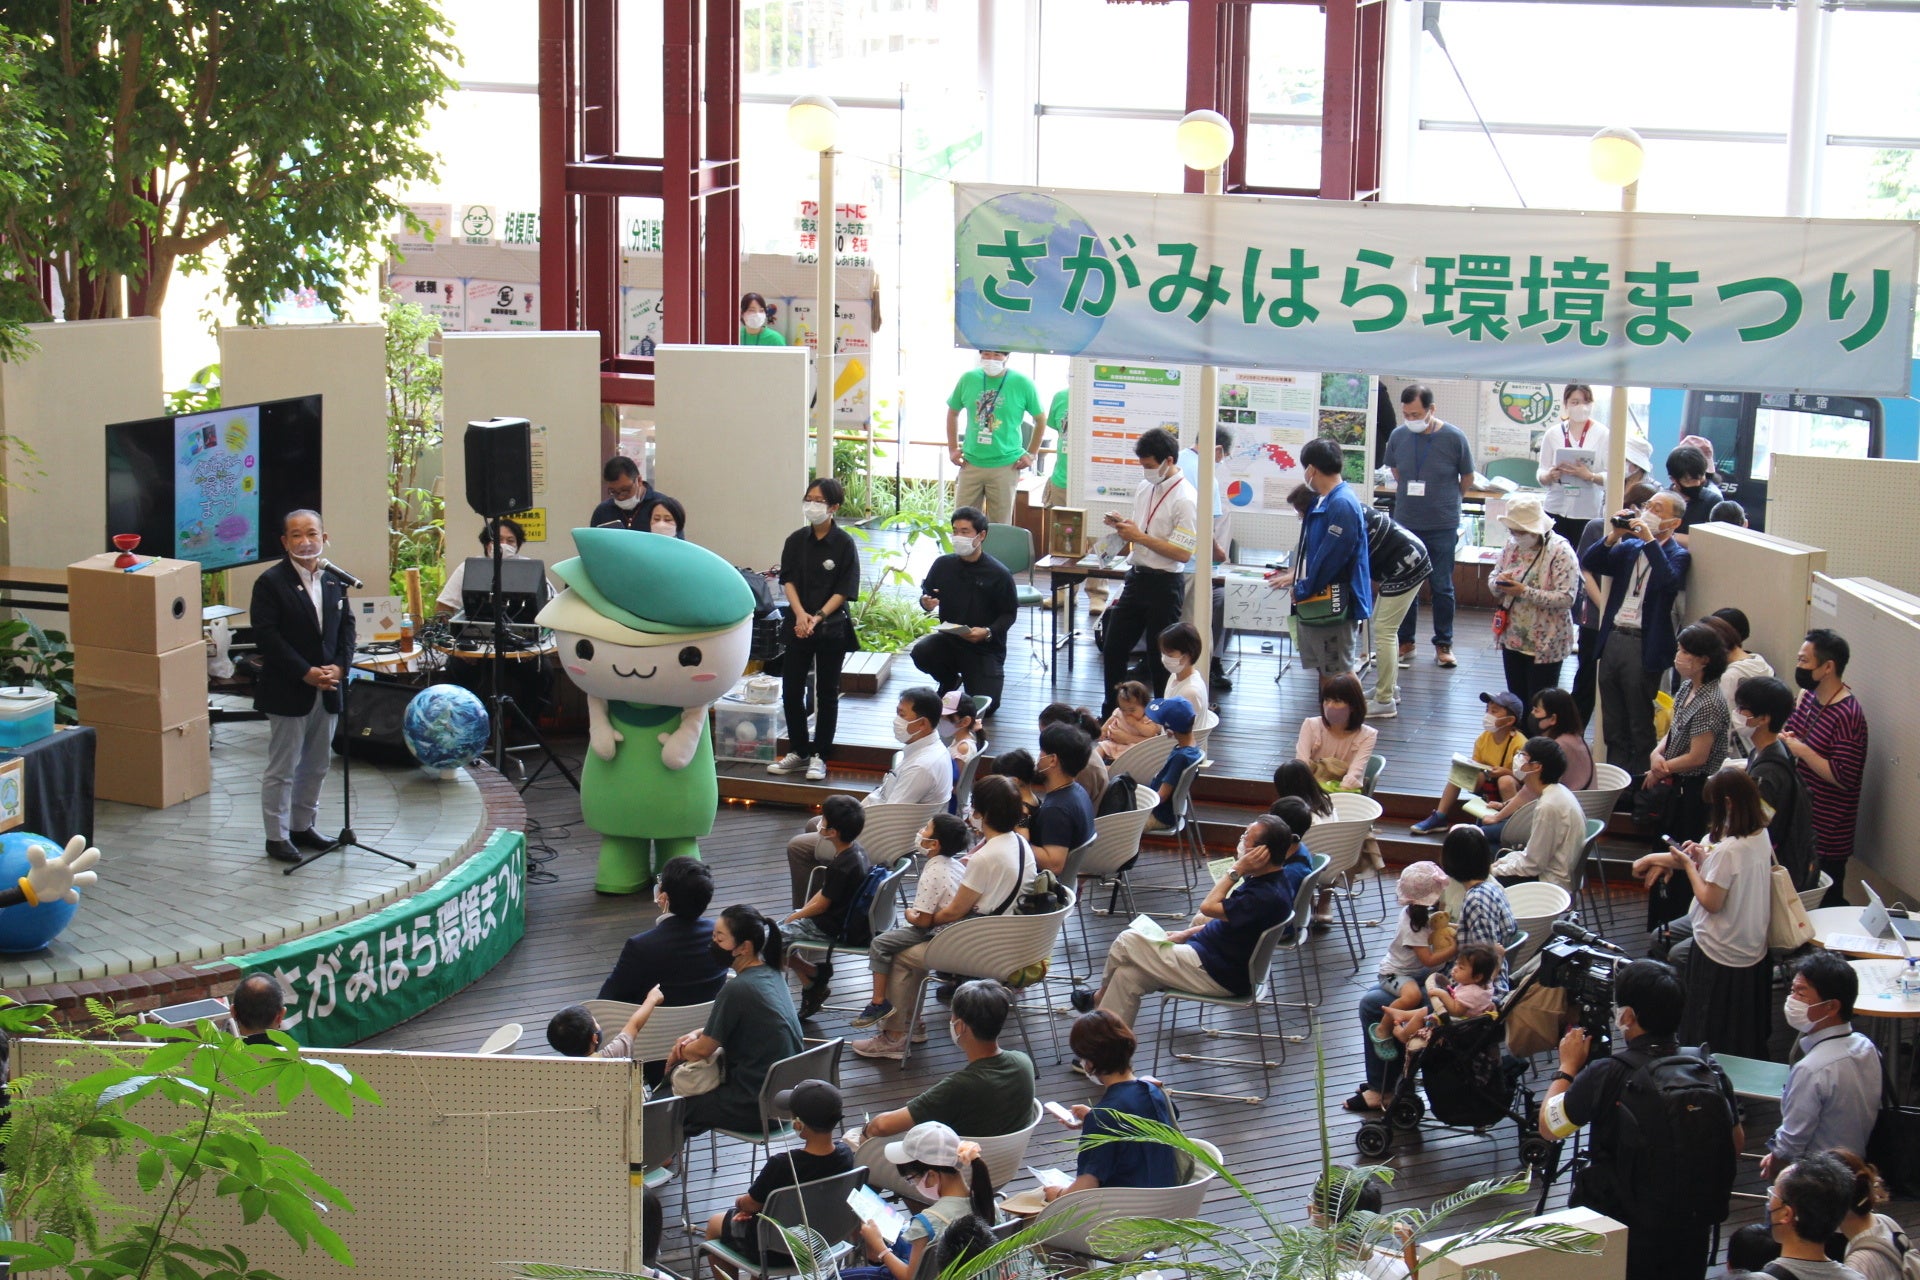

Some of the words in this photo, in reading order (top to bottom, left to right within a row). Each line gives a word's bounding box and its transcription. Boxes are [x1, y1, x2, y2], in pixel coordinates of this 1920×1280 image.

[800, 200, 867, 218] アンートに
[505, 211, 540, 244] 相模原
[415, 280, 438, 294] 紙類
[976, 229, 1891, 352] さがみはら環境まつり
[1238, 601, 1277, 613] ラリー
